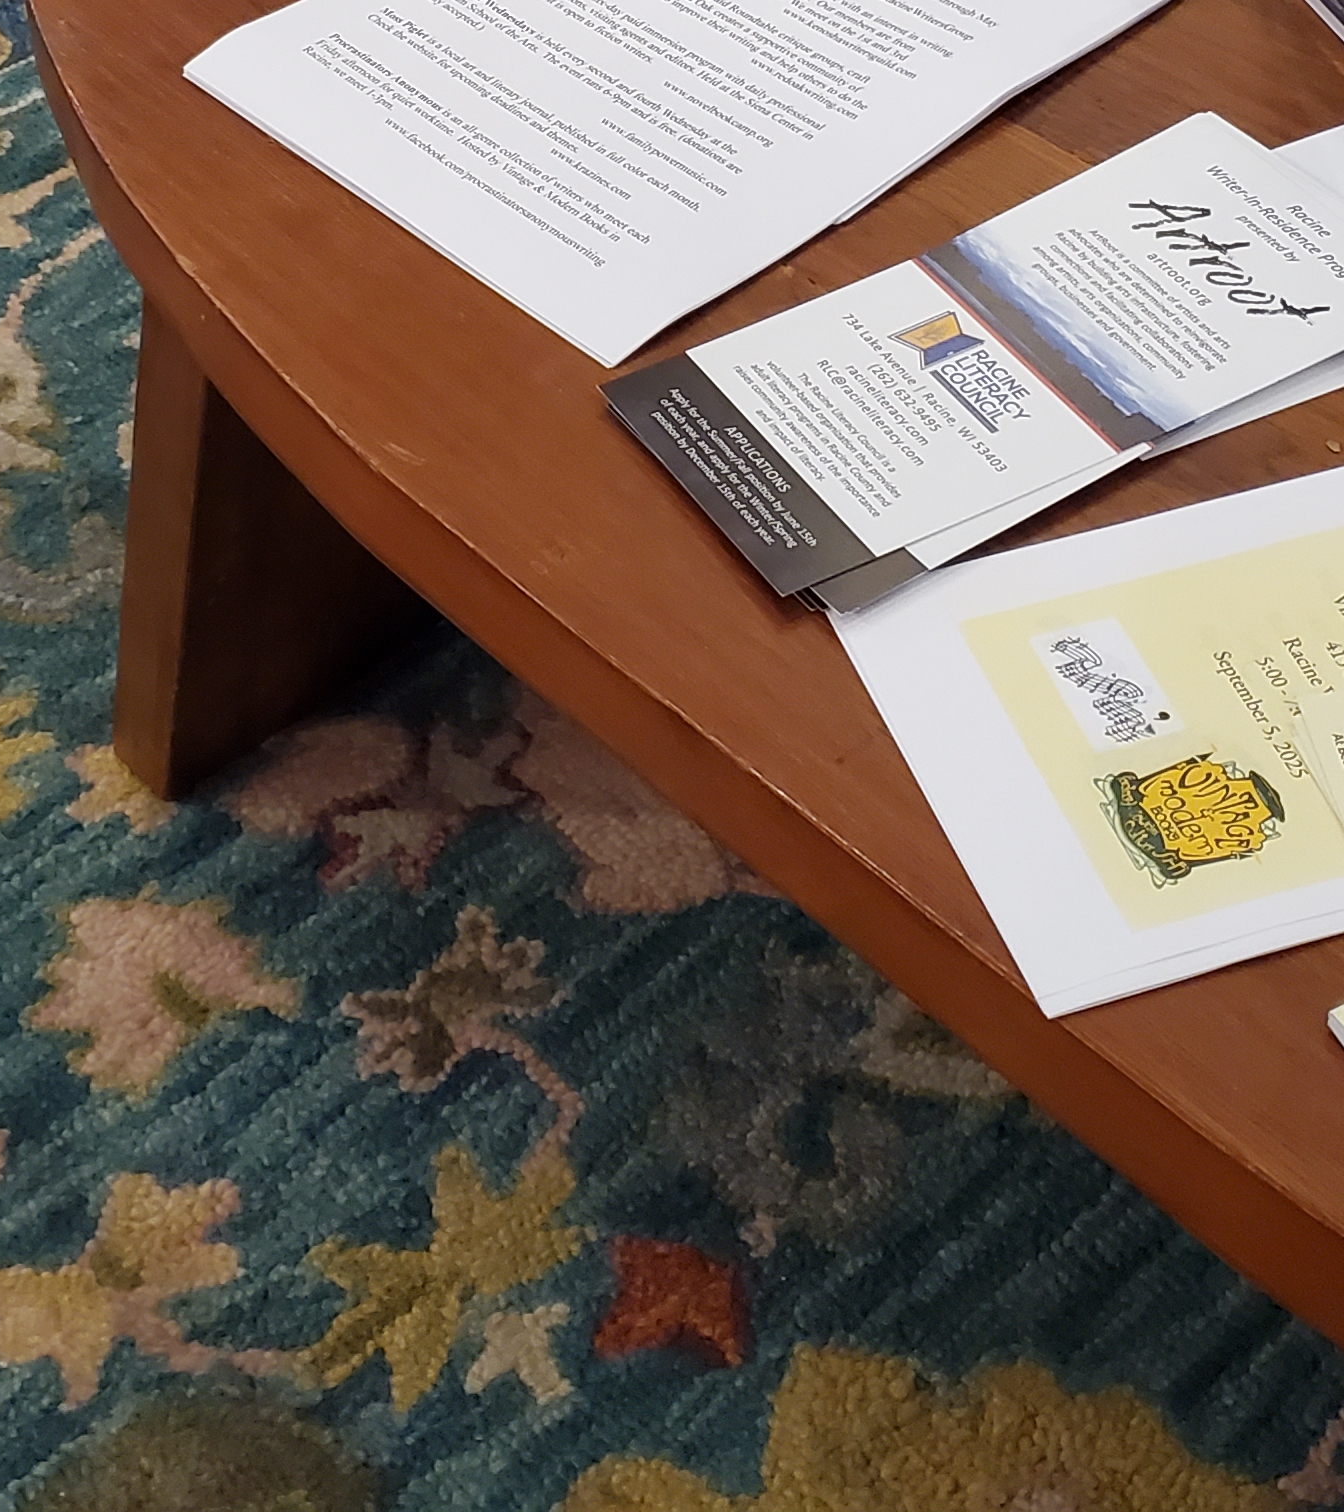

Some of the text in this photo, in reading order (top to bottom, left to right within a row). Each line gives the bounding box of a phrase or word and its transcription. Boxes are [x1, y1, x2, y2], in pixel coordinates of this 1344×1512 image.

[749, 56, 859, 120] www.redoakwriting.com
[1205, 164, 1322, 255] Writer-In-Residence
[1233, 214, 1301, 262] presented by
[1284, 204, 1331, 238] Racine
[1145, 252, 1213, 307] artroot.org
[840, 311, 1008, 473] 734 Lake Avenue Racine, WI 53403
[843, 364, 929, 447] racineliteracy.com
[865, 362, 943, 432] (262) 632-9495
[939, 362, 1005, 425] COUNCIL
[953, 354, 1032, 420] LITERACY
[969, 348, 1031, 401] RACINE
[815, 358, 925, 467] RLC@racineliteracy.com
[722, 425, 792, 493] APPLICATIONS
[1253, 655, 1288, 688] 5:00
[1281, 635, 1323, 687] Racine
[1212, 650, 1270, 723] September
[1271, 740, 1313, 779] 2025
[1330, 732, 1344, 746] At
